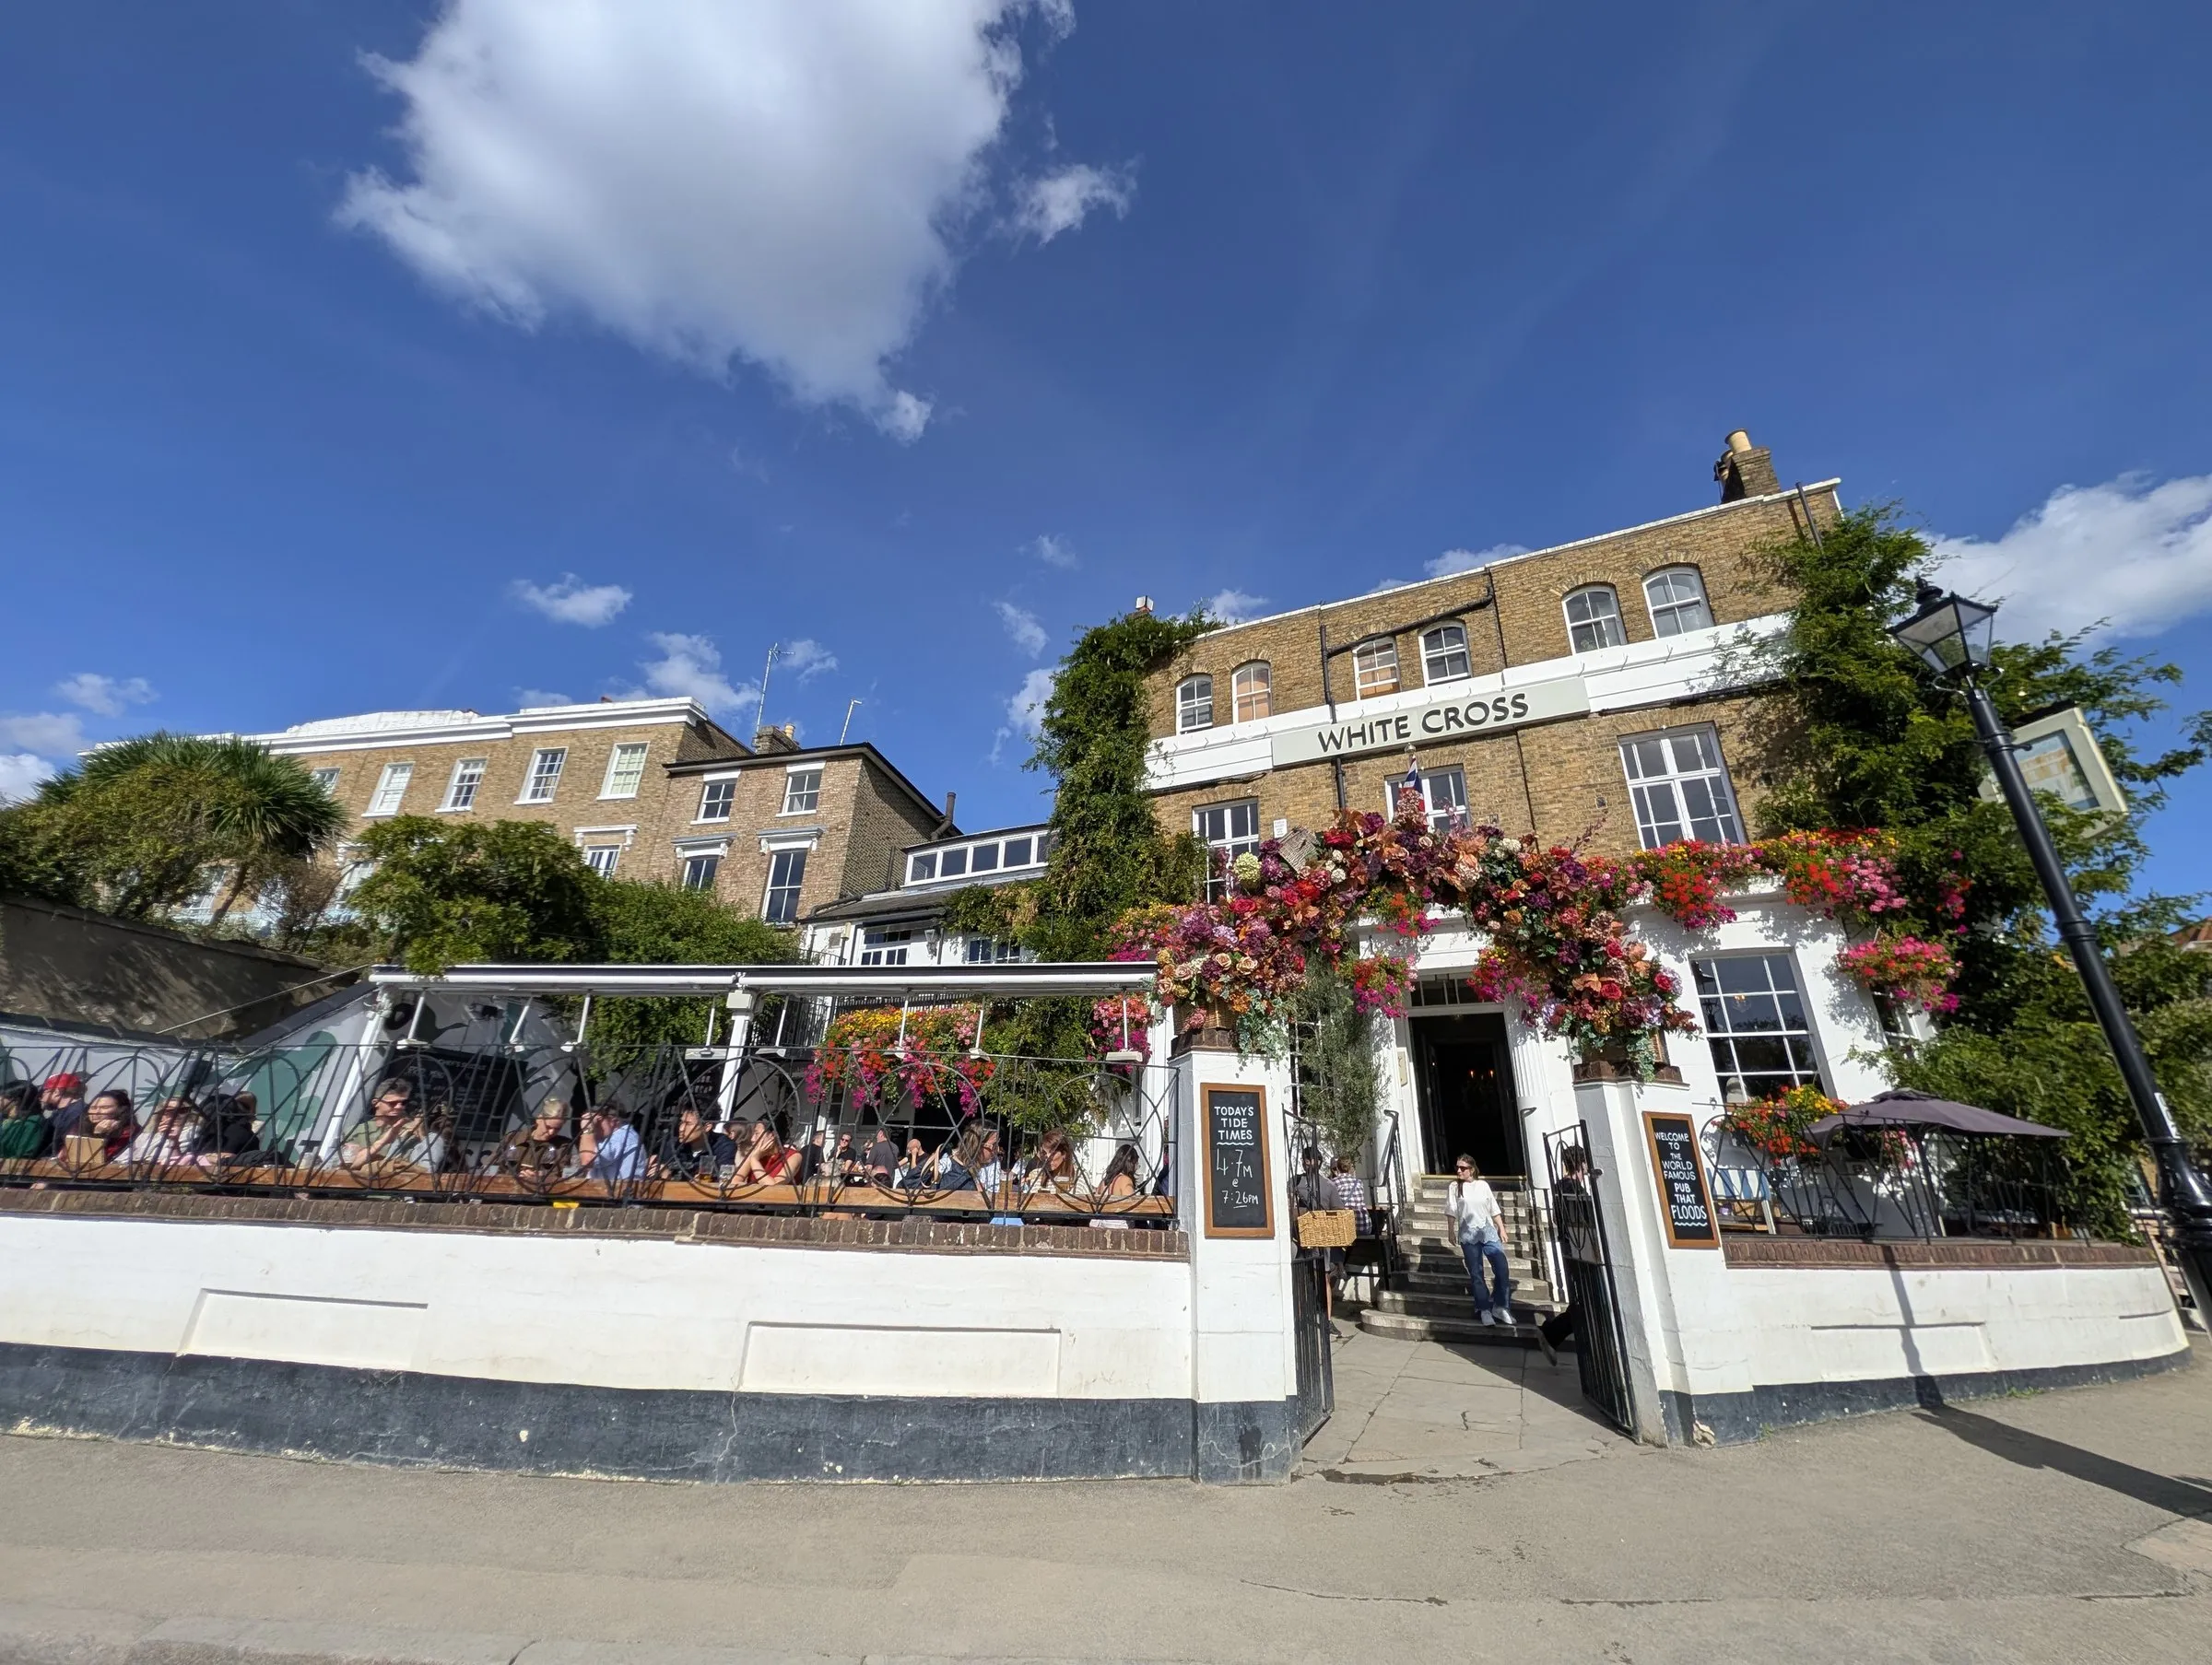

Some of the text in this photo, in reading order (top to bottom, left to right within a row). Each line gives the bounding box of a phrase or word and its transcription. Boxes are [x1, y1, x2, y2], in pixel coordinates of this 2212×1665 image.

[1317, 692, 1529, 753] WHITE CROSS
[1214, 1105, 1254, 1117] TODAY'S
[1220, 1118, 1248, 1128] TIDE
[1218, 1129, 1253, 1141] TIMES
[1654, 1131, 1690, 1143] WELCOME
[1668, 1142, 1680, 1151] TO
[1669, 1153, 1683, 1161] THE
[1662, 1160, 1693, 1170] WORLD
[1663, 1170, 1697, 1181] FAMOUS
[1674, 1182, 1691, 1193] PUB
[1221, 1190, 1259, 1205] 7:26PM
[1674, 1193, 1696, 1204] THAT
[1670, 1204, 1707, 1220] FLOODS
